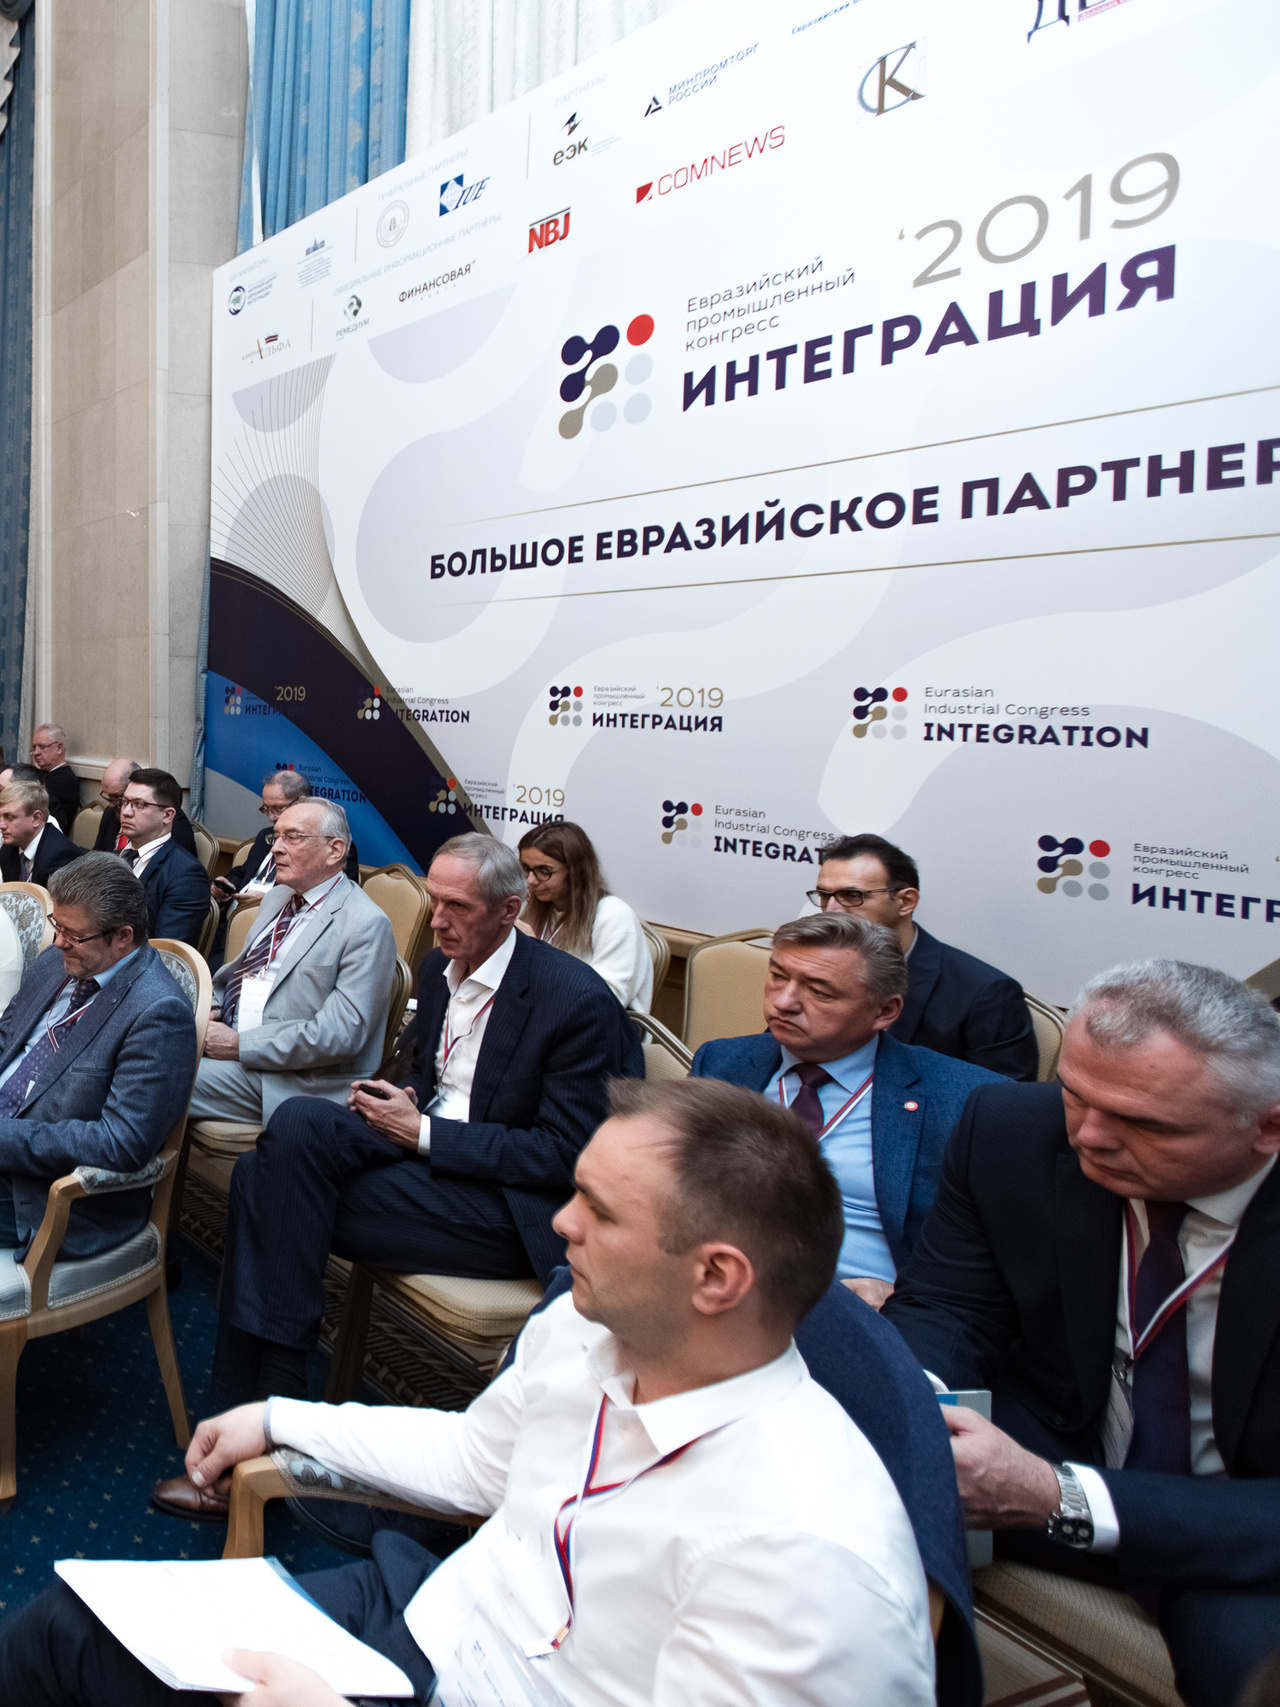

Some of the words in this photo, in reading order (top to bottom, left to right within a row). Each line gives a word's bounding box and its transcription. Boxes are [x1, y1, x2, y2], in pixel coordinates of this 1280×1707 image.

[668, 42, 760, 95] МИНПРОМТОРГ
[668, 74, 718, 106] РОССИИ
[657, 125, 786, 197] COMNEWS
[527, 211, 572, 255] NBJ
[398, 262, 472, 303] ФИНАНСОВАЯ
[686, 255, 824, 313] Евразийский
[685, 266, 856, 333] промышленный
[682, 243, 1177, 412] ИНТЕГРАЦИЯ
[685, 315, 780, 352] конгресс
[429, 534, 586, 580] БОЛЬШОЕ
[595, 485, 940, 561] ЕВРАЗИЙСКОЕ
[386, 686, 414, 694] Eurasian
[593, 685, 637, 694] Евразийский
[593, 692, 646, 701] промышленный
[924, 686, 995, 698] Eurasian
[416, 696, 450, 707] Congress
[924, 703, 1000, 715] Industrial
[1004, 703, 1091, 720] Congress
[592, 712, 724, 733] ИНТЕГРАЦИЯ
[922, 722, 1150, 750] INTEGRATION
[298, 764, 322, 773] Eurasian
[323, 776, 351, 786] Congress
[464, 778, 499, 788] Евразийский
[309, 785, 368, 803] TEGRATION
[715, 805, 766, 819] Eurasian
[714, 819, 770, 834] Industrial
[773, 825, 836, 841] Congress
[713, 835, 824, 866] INTEGRAT
[1133, 843, 1229, 861] Евразийский
[1132, 855, 1250, 874] промышленный
[1132, 866, 1201, 880] конгресс
